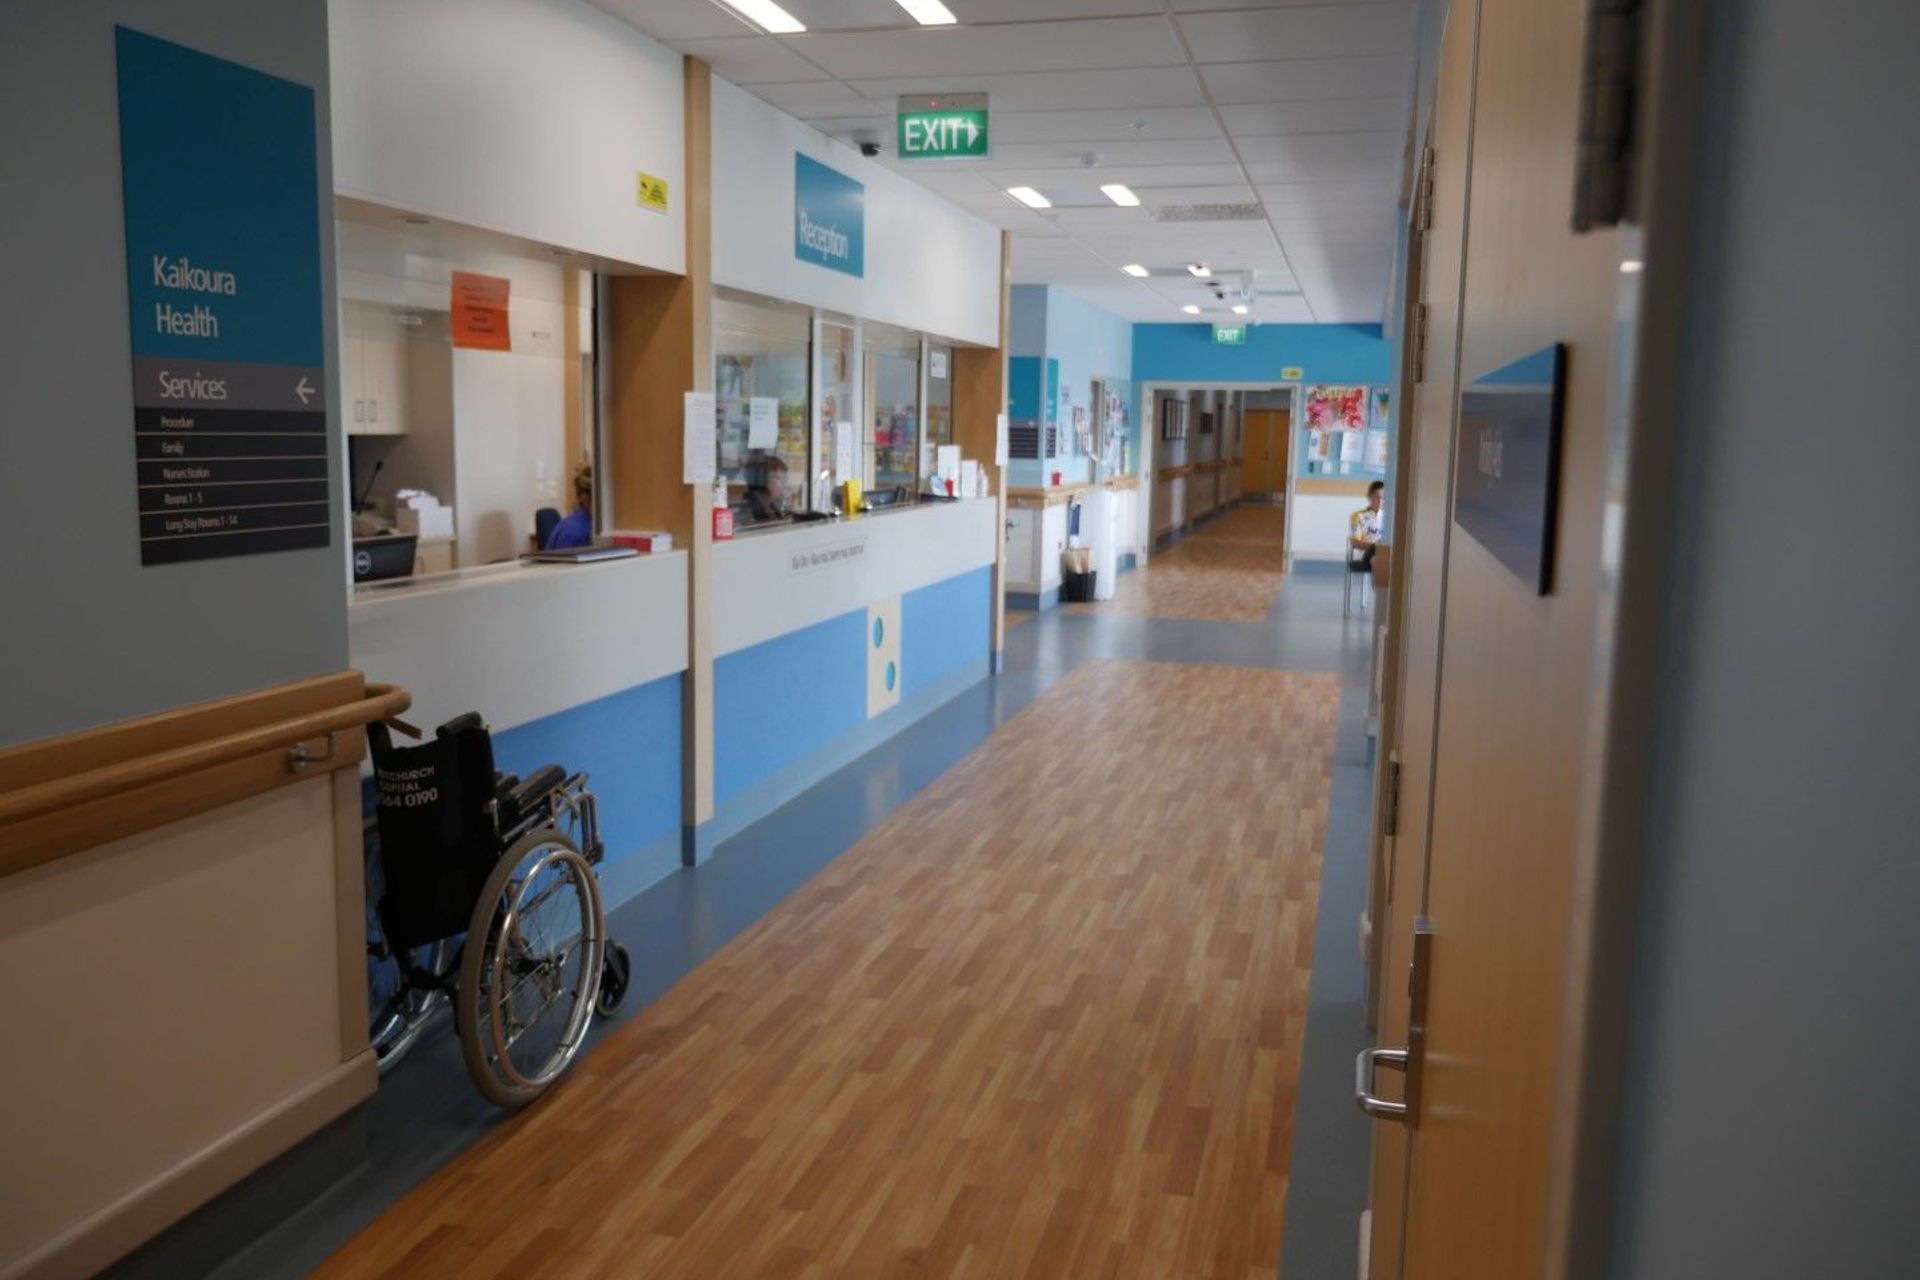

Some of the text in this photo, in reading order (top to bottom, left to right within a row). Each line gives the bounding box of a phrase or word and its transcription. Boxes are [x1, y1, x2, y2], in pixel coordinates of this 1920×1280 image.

[905, 118, 962, 151] EXIT
[800, 210, 848, 261] Reception
[153, 255, 236, 295] Kaikoura
[156, 303, 219, 338] Health
[1217, 329, 1239, 342] EXIT
[159, 371, 227, 400] Services
[162, 442, 184, 456] Family
[164, 493, 188, 505] Rooms
[165, 519, 183, 533] Long
[405, 787, 438, 807] 0190
